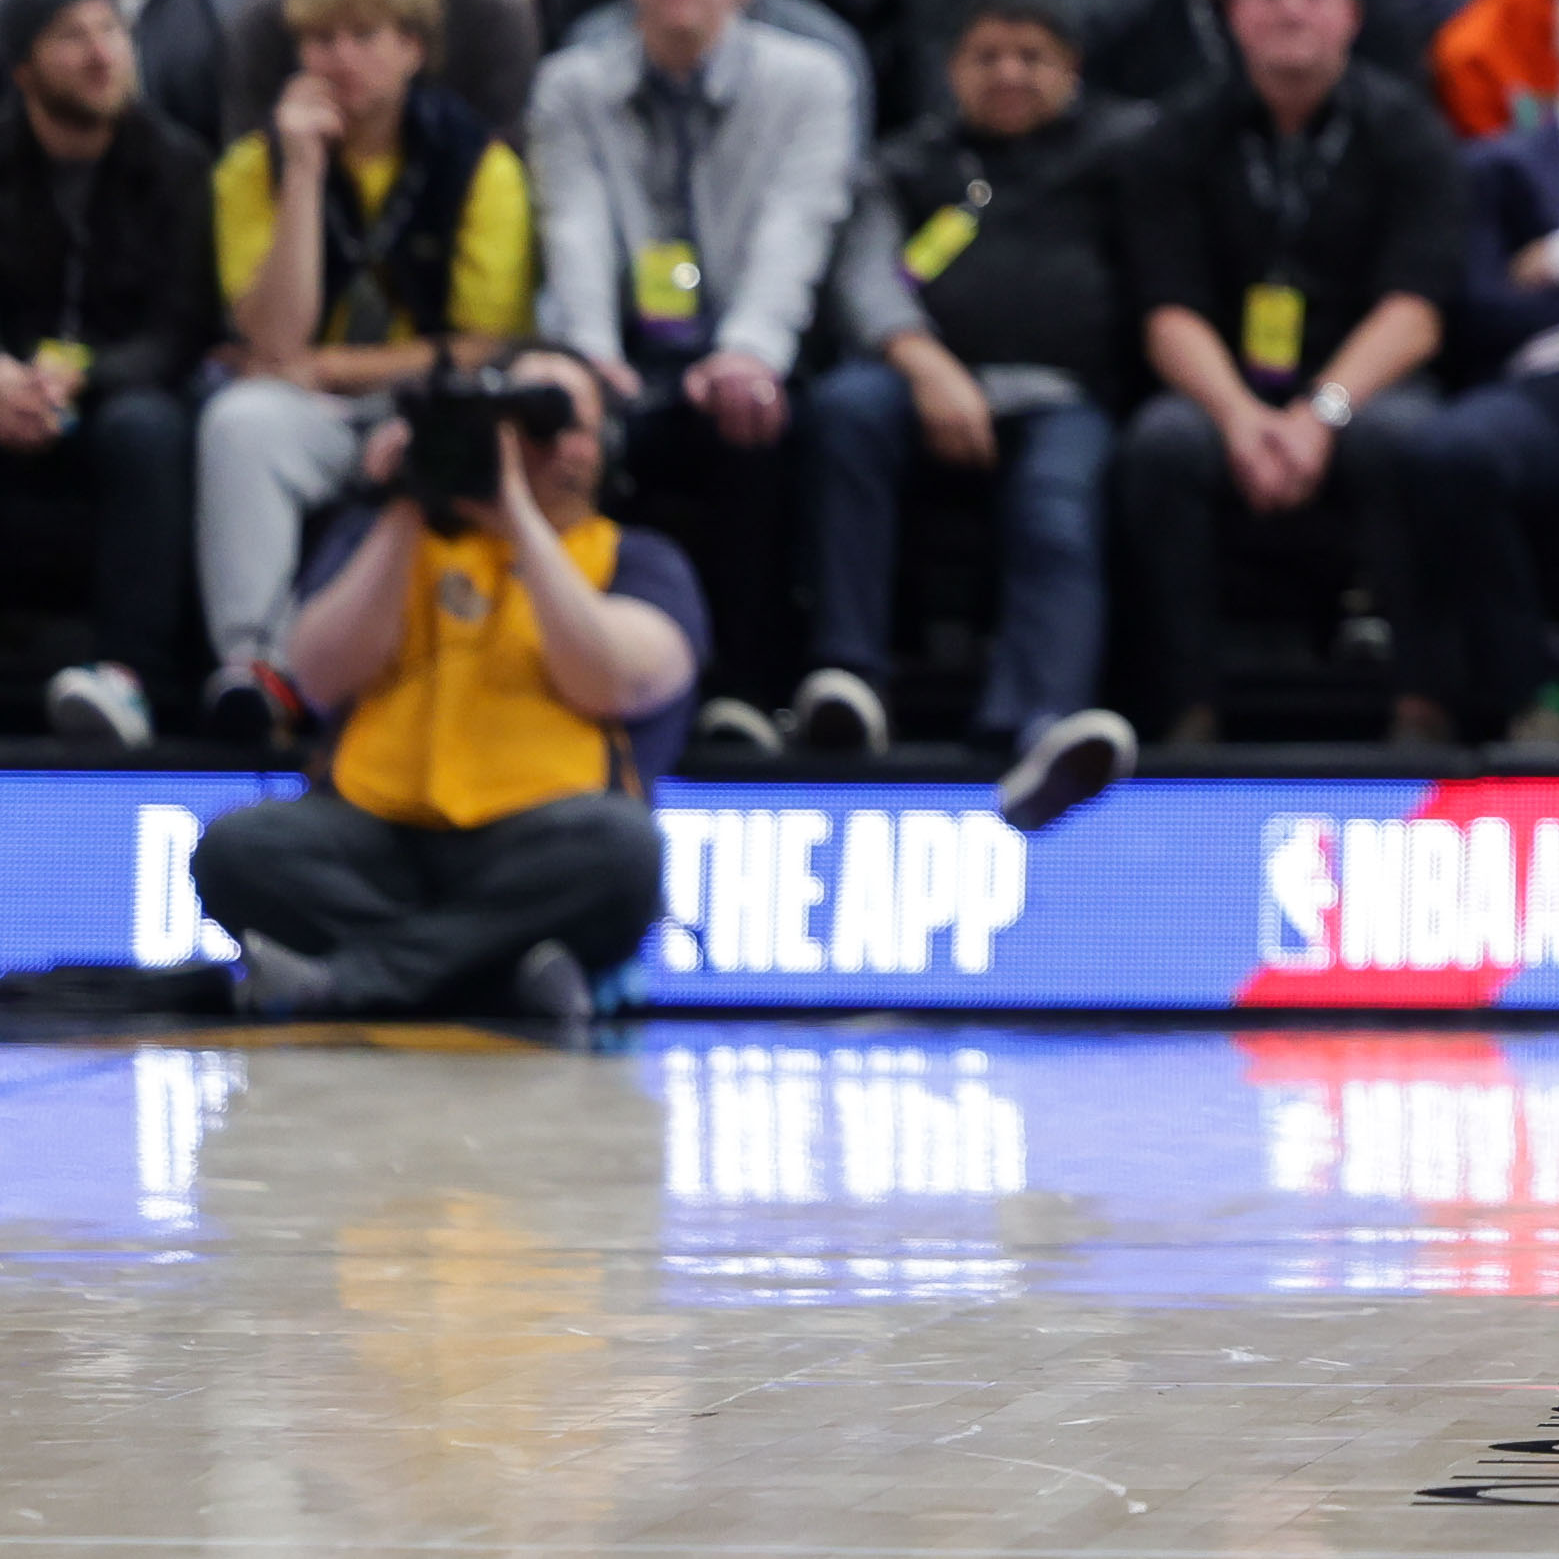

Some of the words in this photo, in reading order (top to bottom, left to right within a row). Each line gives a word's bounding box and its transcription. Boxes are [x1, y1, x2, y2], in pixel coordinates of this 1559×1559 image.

[655, 809, 833, 973] THE
[830, 810, 1028, 975] APP
[1341, 817, 1522, 972] NBA
